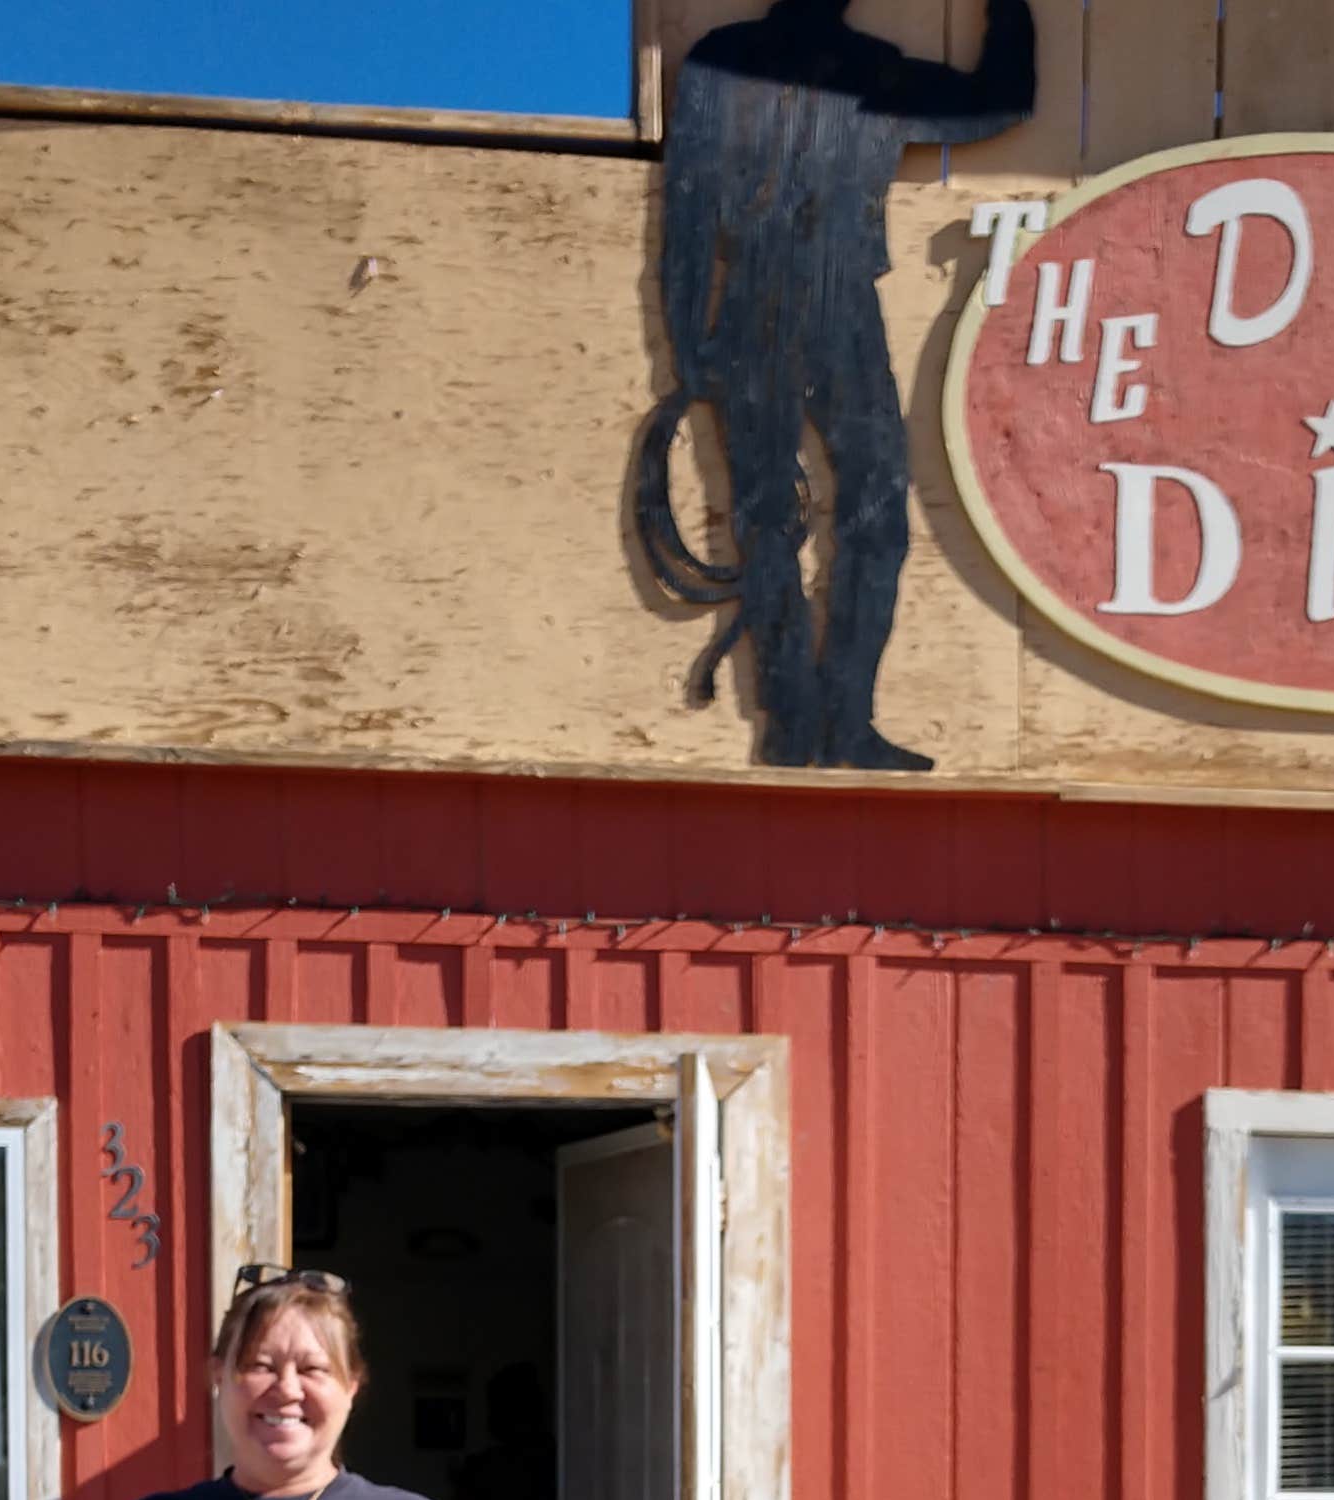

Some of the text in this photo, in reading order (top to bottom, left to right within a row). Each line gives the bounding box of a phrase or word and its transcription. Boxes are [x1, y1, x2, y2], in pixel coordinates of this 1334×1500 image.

[970, 199, 1160, 424] THE
[100, 1121, 161, 1270] 323
[70, 1341, 109, 1368] 116
